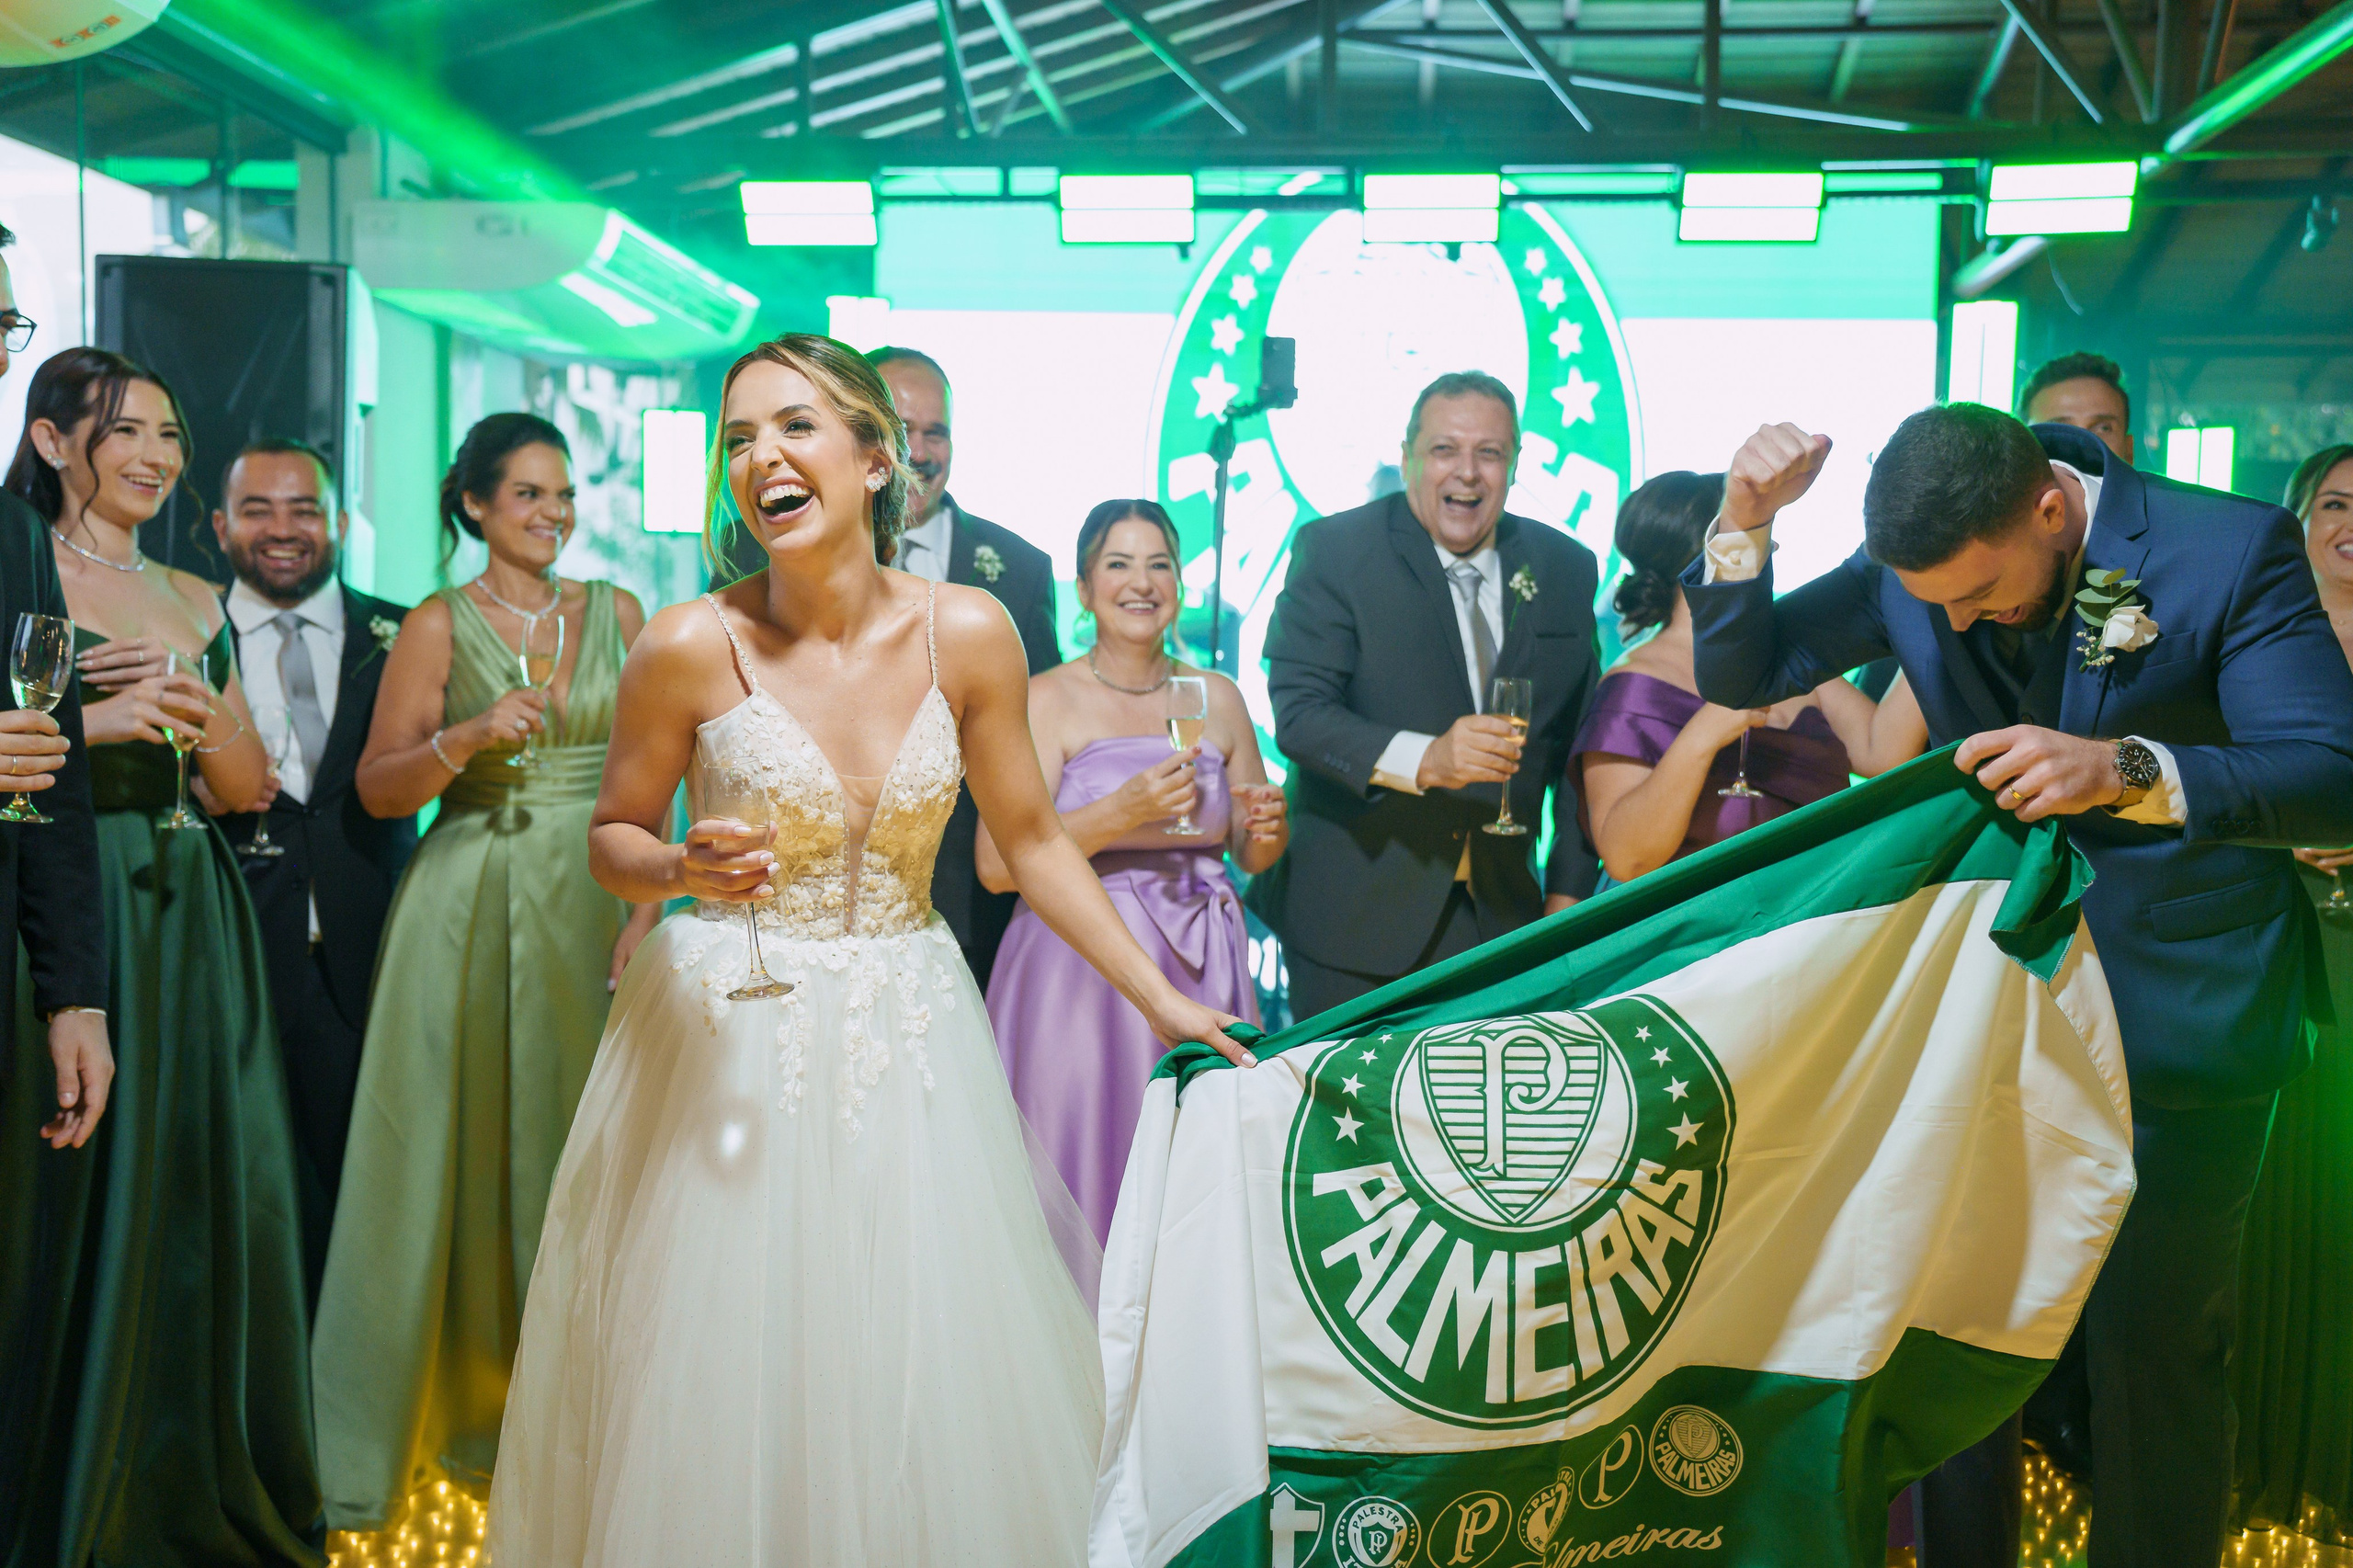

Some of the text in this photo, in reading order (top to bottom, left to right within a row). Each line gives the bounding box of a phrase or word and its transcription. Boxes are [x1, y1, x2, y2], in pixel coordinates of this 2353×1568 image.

[1312, 1157, 1703, 1404] PALMEIRAS
[1654, 1441, 1736, 1491] PALMEIRAS
[1352, 1506, 1404, 1533] PALESTRA
